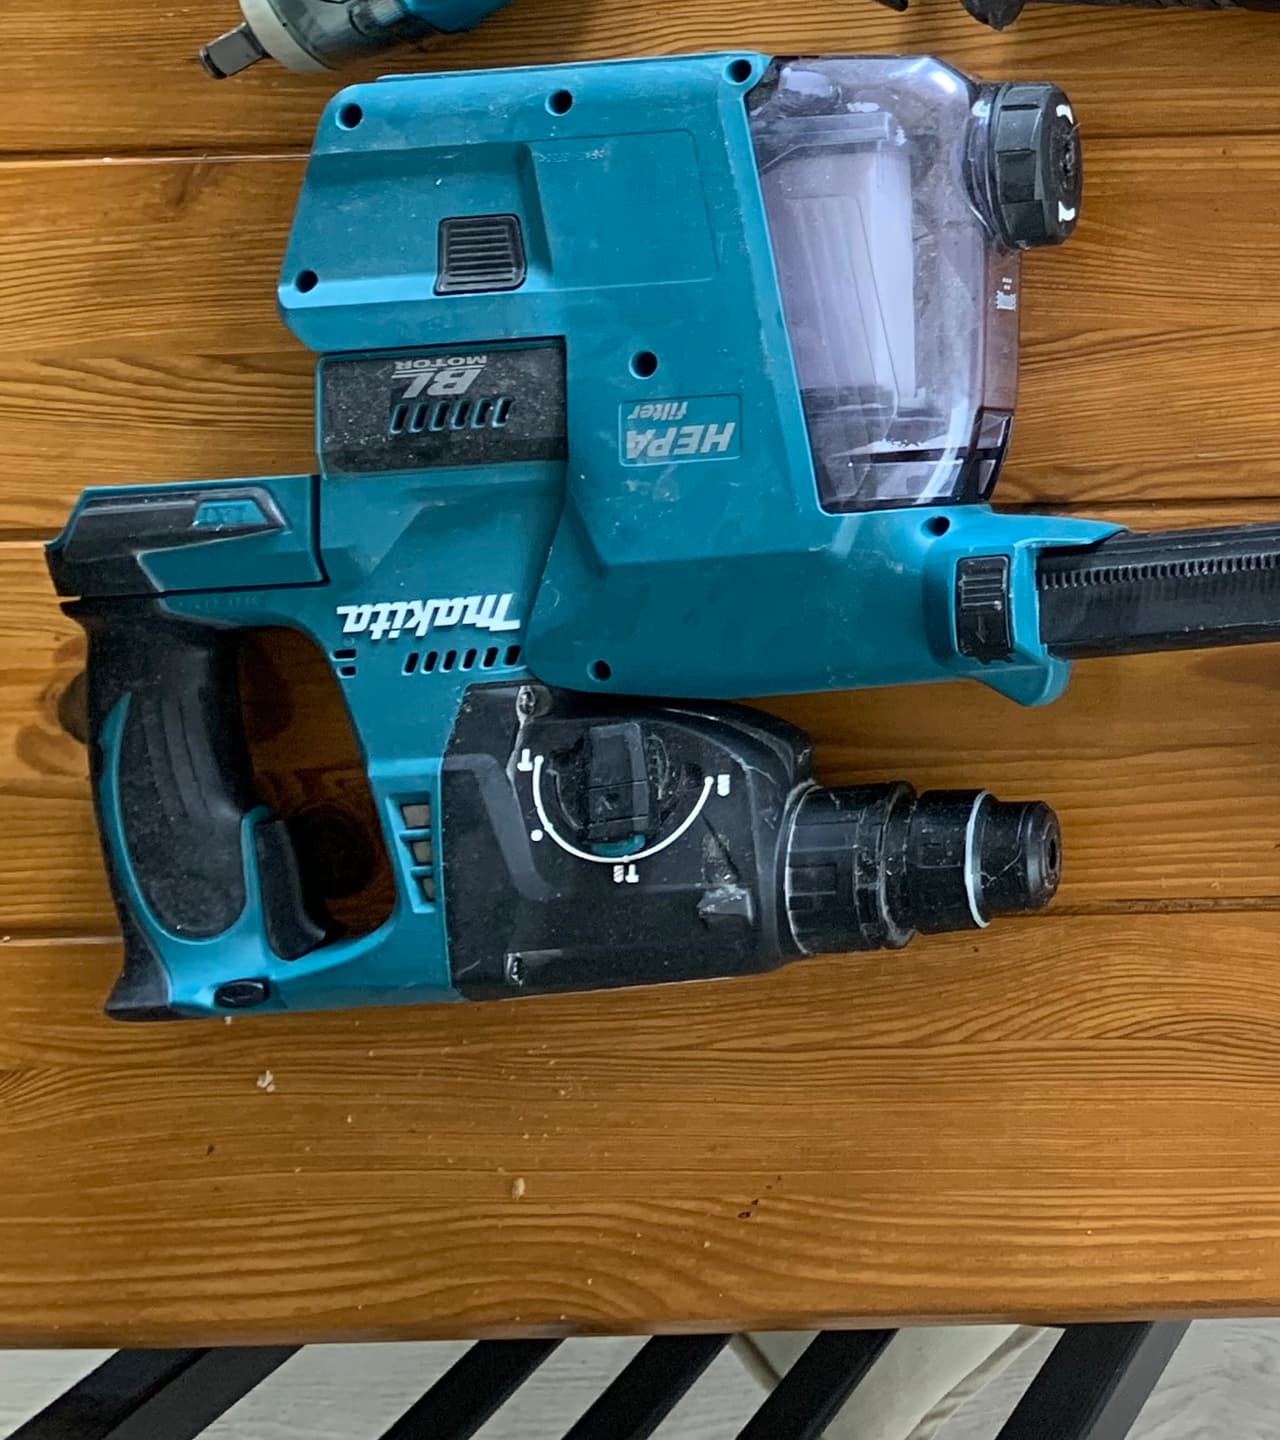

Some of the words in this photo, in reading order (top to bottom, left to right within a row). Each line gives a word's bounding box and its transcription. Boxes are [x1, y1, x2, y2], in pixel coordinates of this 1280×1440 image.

[394, 354, 487, 369] MOTOR
[390, 368, 481, 398] BL
[626, 400, 688, 421] filter
[625, 421, 736, 458] HEPA
